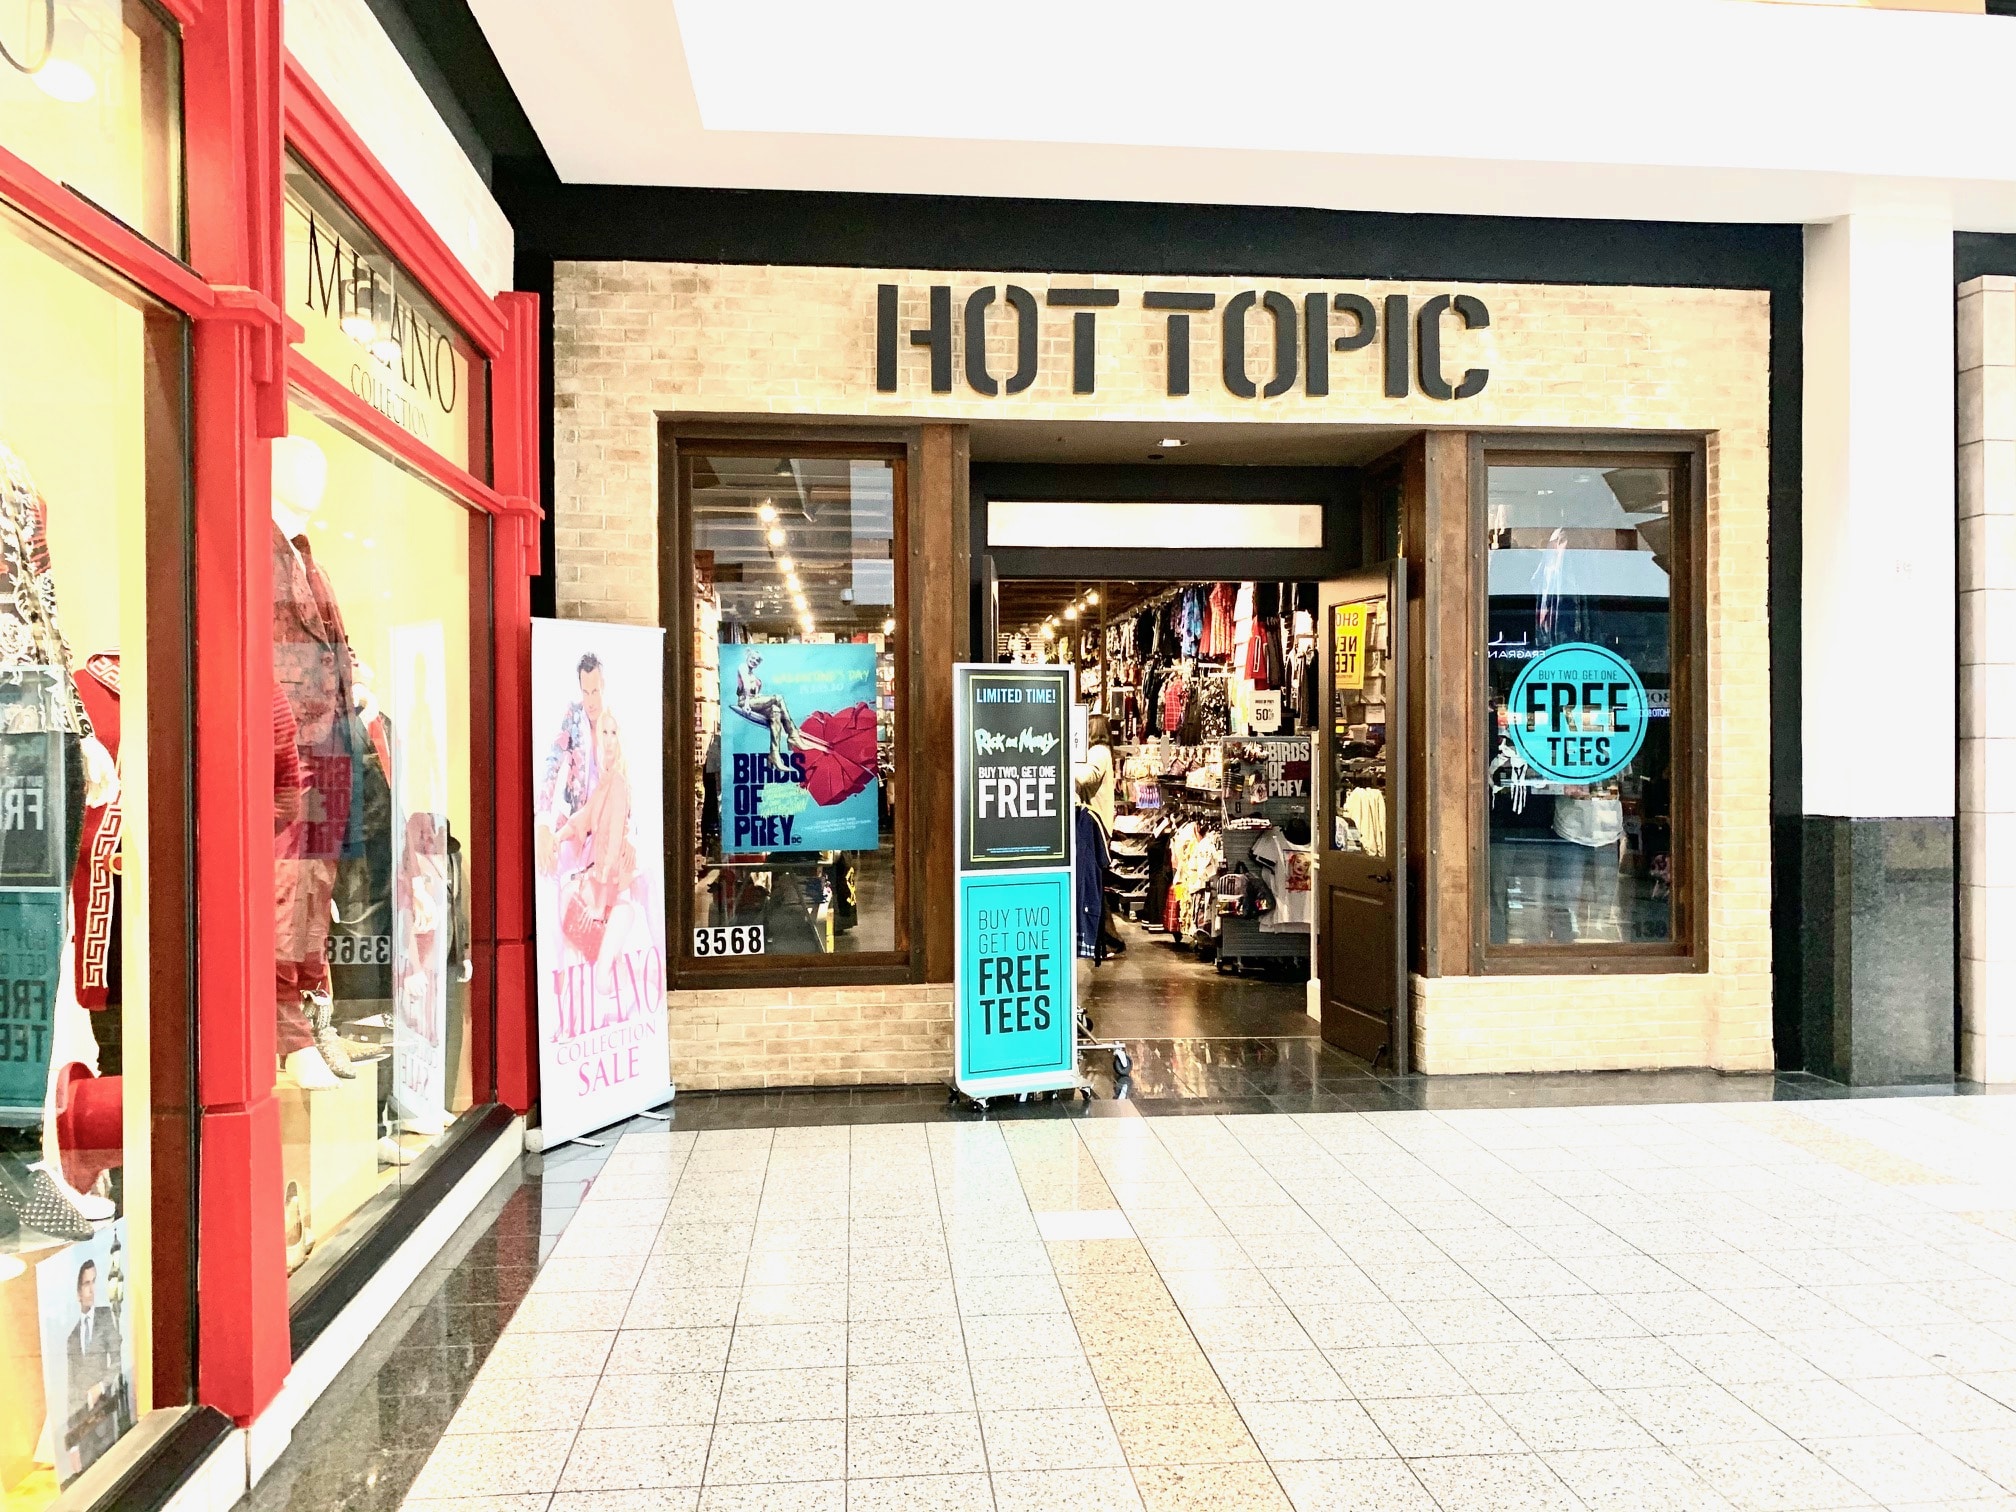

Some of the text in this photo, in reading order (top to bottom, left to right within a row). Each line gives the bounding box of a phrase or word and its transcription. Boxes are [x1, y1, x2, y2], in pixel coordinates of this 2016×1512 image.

[305, 210, 456, 413] MILANO
[876, 284, 1490, 400] HOT TOPIC
[350, 363, 429, 438] COLLECTION
[1538, 669, 1556, 680] BUY
[1582, 669, 1598, 680] GET
[1600, 669, 1618, 680] ONE
[976, 688, 1056, 704] LIMITED TIME!
[1525, 682, 1630, 733] FREE
[732, 752, 806, 784] BIRDS
[1268, 742, 1310, 762] BIRDS
[1547, 737, 1611, 767] TEES
[978, 765, 1056, 780] BUY TWO, GET ONE
[1268, 762, 1287, 780] OF
[734, 784, 764, 816] OF
[978, 778, 1057, 819] FREE
[1268, 780, 1303, 797] PREY
[734, 815, 795, 847] PREY
[979, 906, 1050, 931] BUY TWO
[696, 926, 762, 955] 3568
[979, 930, 1050, 954] GET ONE
[979, 953, 1050, 996] FREE
[550, 946, 662, 1044] MILANO
[979, 994, 1051, 1035] TEES
[557, 1020, 657, 1065] COLLECTION
[578, 1046, 640, 1097] SALE
